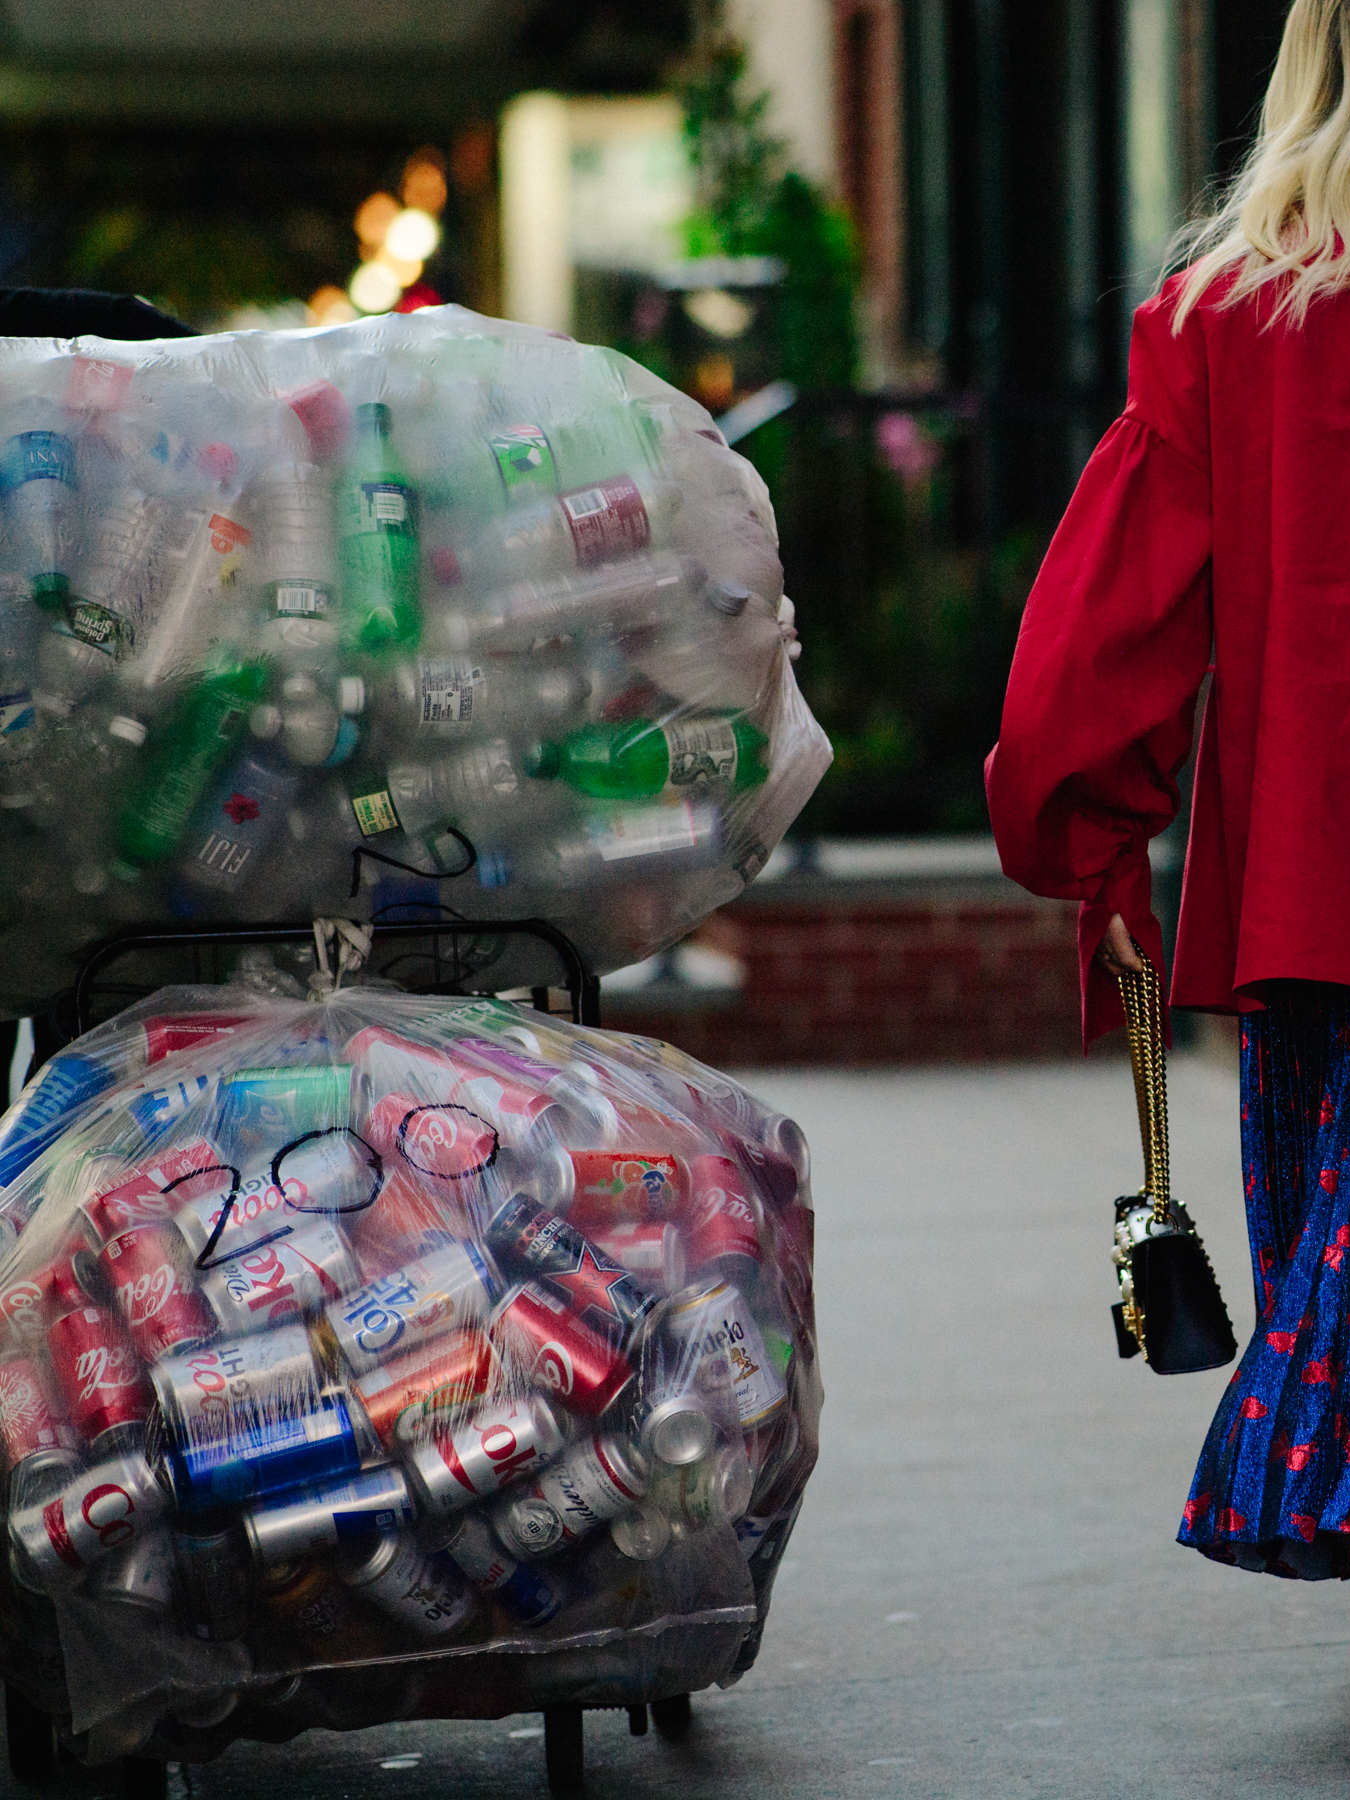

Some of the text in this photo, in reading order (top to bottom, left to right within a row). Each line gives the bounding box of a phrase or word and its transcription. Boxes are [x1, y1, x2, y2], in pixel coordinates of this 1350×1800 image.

[200, 834, 251, 875] FIJI
[15, 1063, 79, 1141] LIGHT
[368, 1270, 418, 1307] 45
[343, 1289, 406, 1355] Colt
[218, 1348, 251, 1400] GHT
